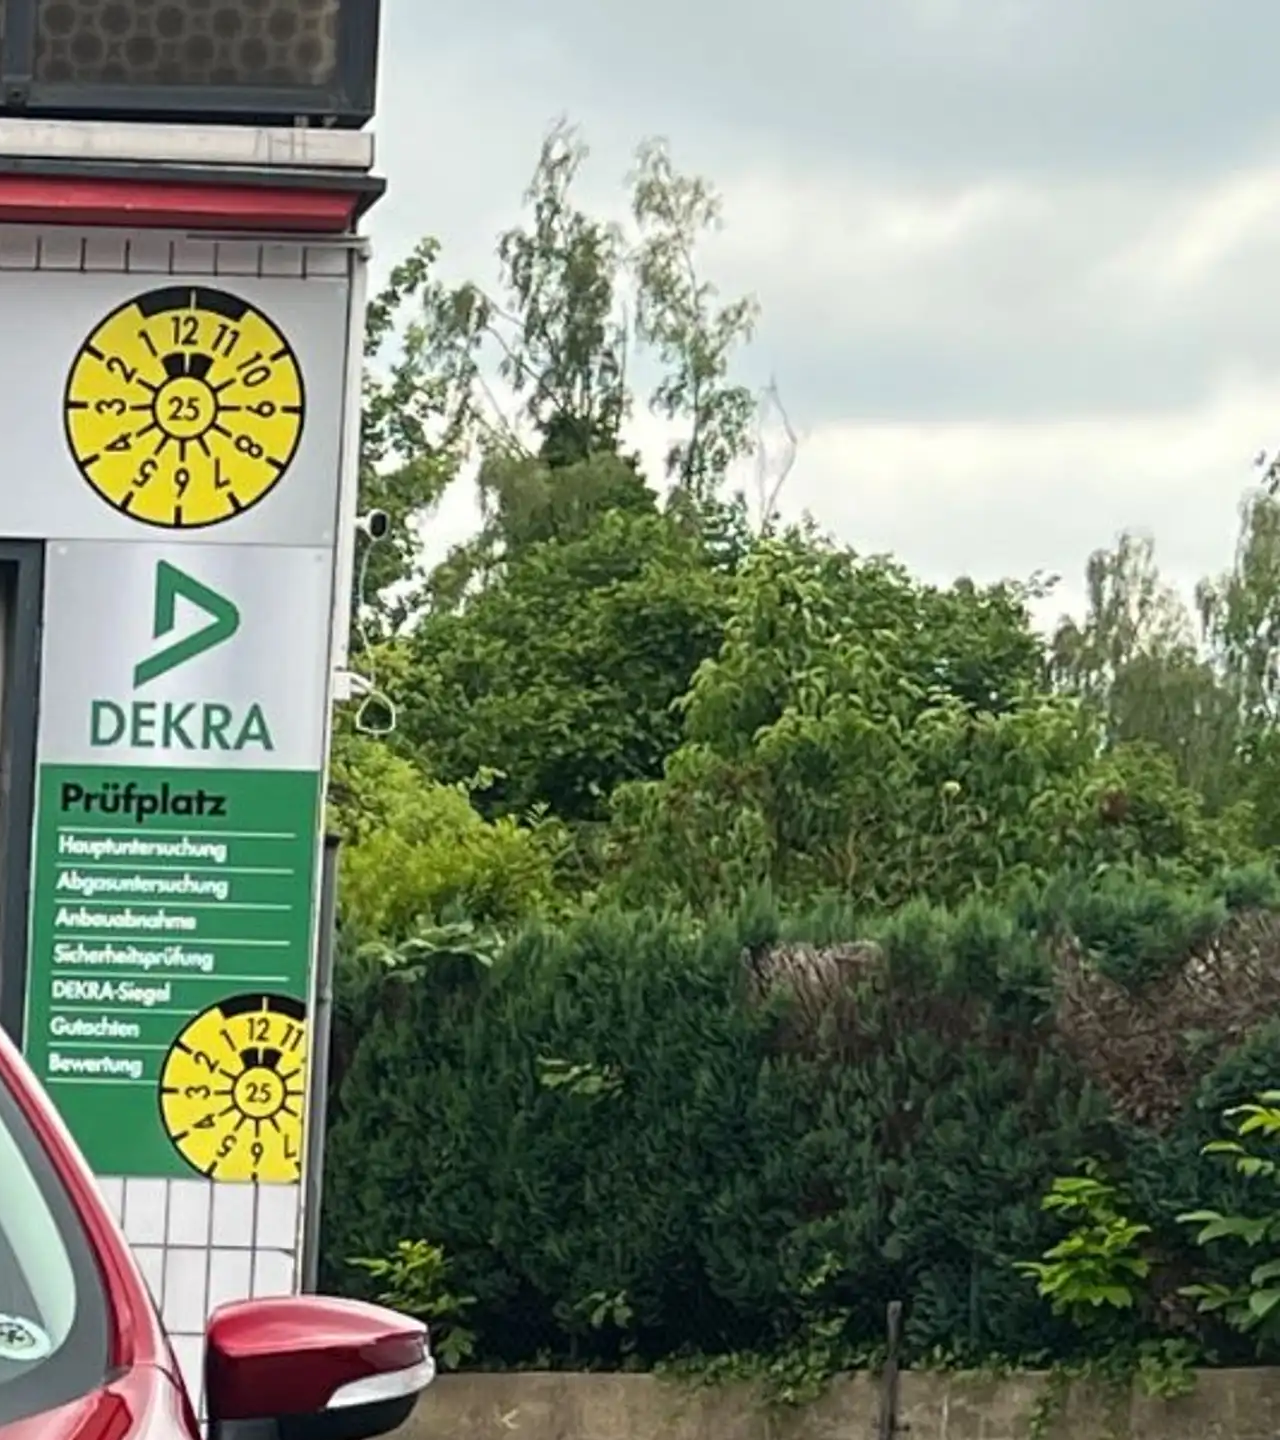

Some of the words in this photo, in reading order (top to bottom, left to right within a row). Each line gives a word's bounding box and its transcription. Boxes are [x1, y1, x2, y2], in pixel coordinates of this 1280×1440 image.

[138, 329, 157, 357] 1
[171, 316, 198, 346] 12
[212, 323, 240, 357] 11
[106, 357, 137, 383] 2
[236, 352, 271, 387] 10
[95, 398, 127, 415] 3
[168, 396, 200, 421] 25
[104, 432, 132, 451] 4
[234, 434, 263, 459] 8
[132, 458, 158, 487] 5
[90, 700, 273, 750] DEKRA
[61, 782, 227, 823] Prüfplatz
[58, 836, 227, 863] Hauptuntersuchung
[57, 871, 229, 899] Abgasuntersuchung
[55, 907, 197, 930] Anbauabnahme
[53, 944, 214, 972] Sicherheitsprüfung
[51, 981, 171, 1006] DEKRA-Siegel
[50, 1018, 140, 1039] Gutachten
[248, 1018, 270, 1043] 12
[280, 1024, 303, 1049] 11
[48, 1053, 143, 1080] Bewertung
[194, 1051, 220, 1073] 2
[184, 1084, 212, 1099] 3
[245, 1082, 272, 1102] 25
